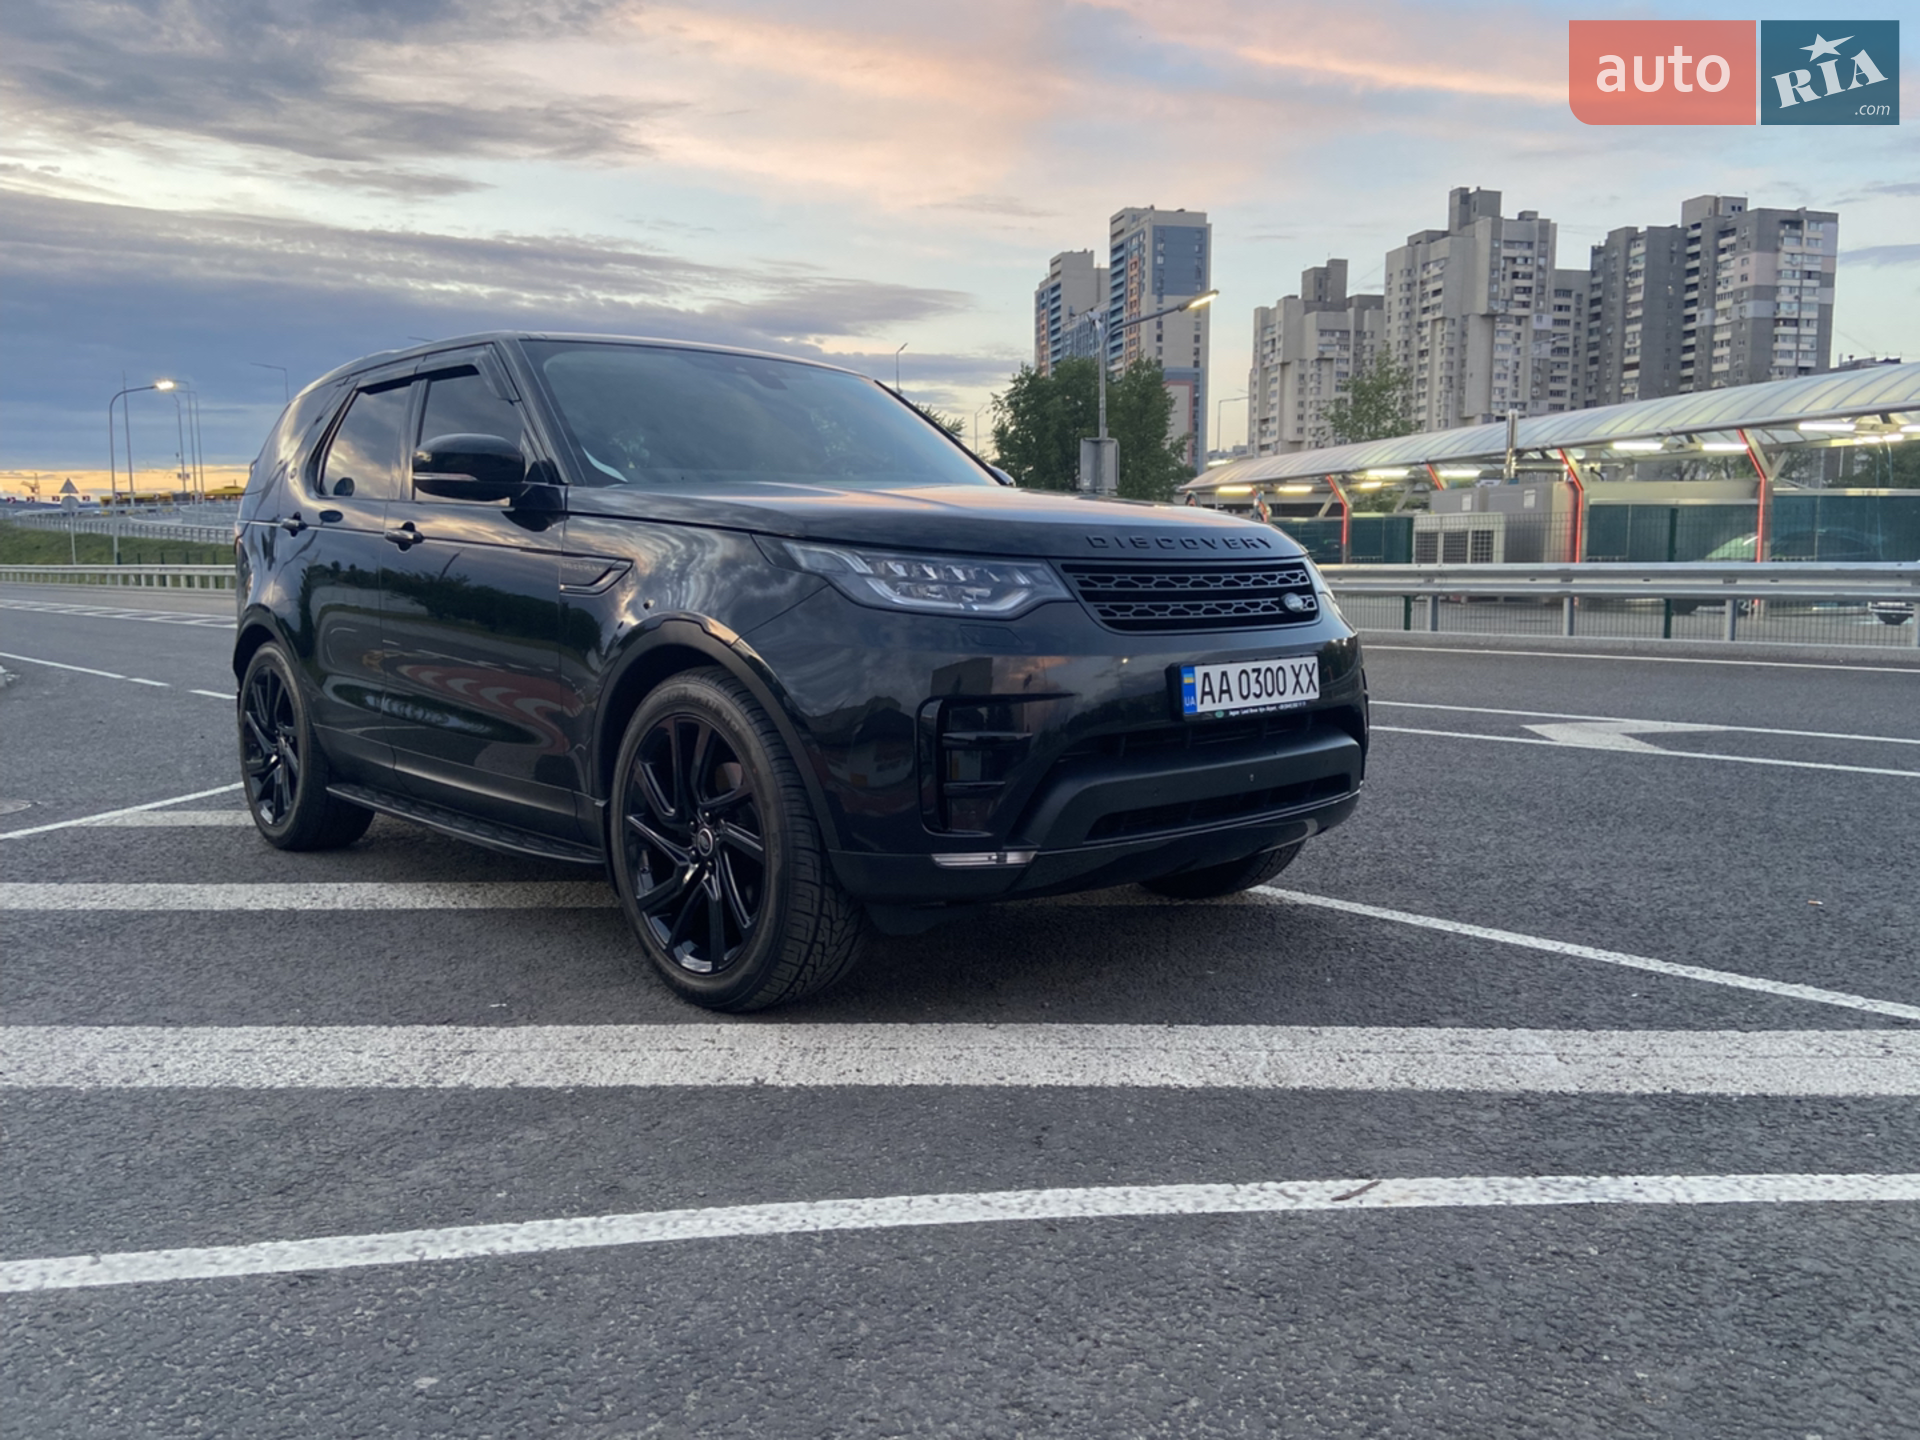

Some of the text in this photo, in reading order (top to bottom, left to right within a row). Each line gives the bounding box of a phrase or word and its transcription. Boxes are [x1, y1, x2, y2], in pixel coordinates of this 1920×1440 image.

[1085, 535, 1273, 550] DISCOVERY
[1200, 662, 1318, 705] AA 0300 XX
[1184, 695, 1197, 707] UA
